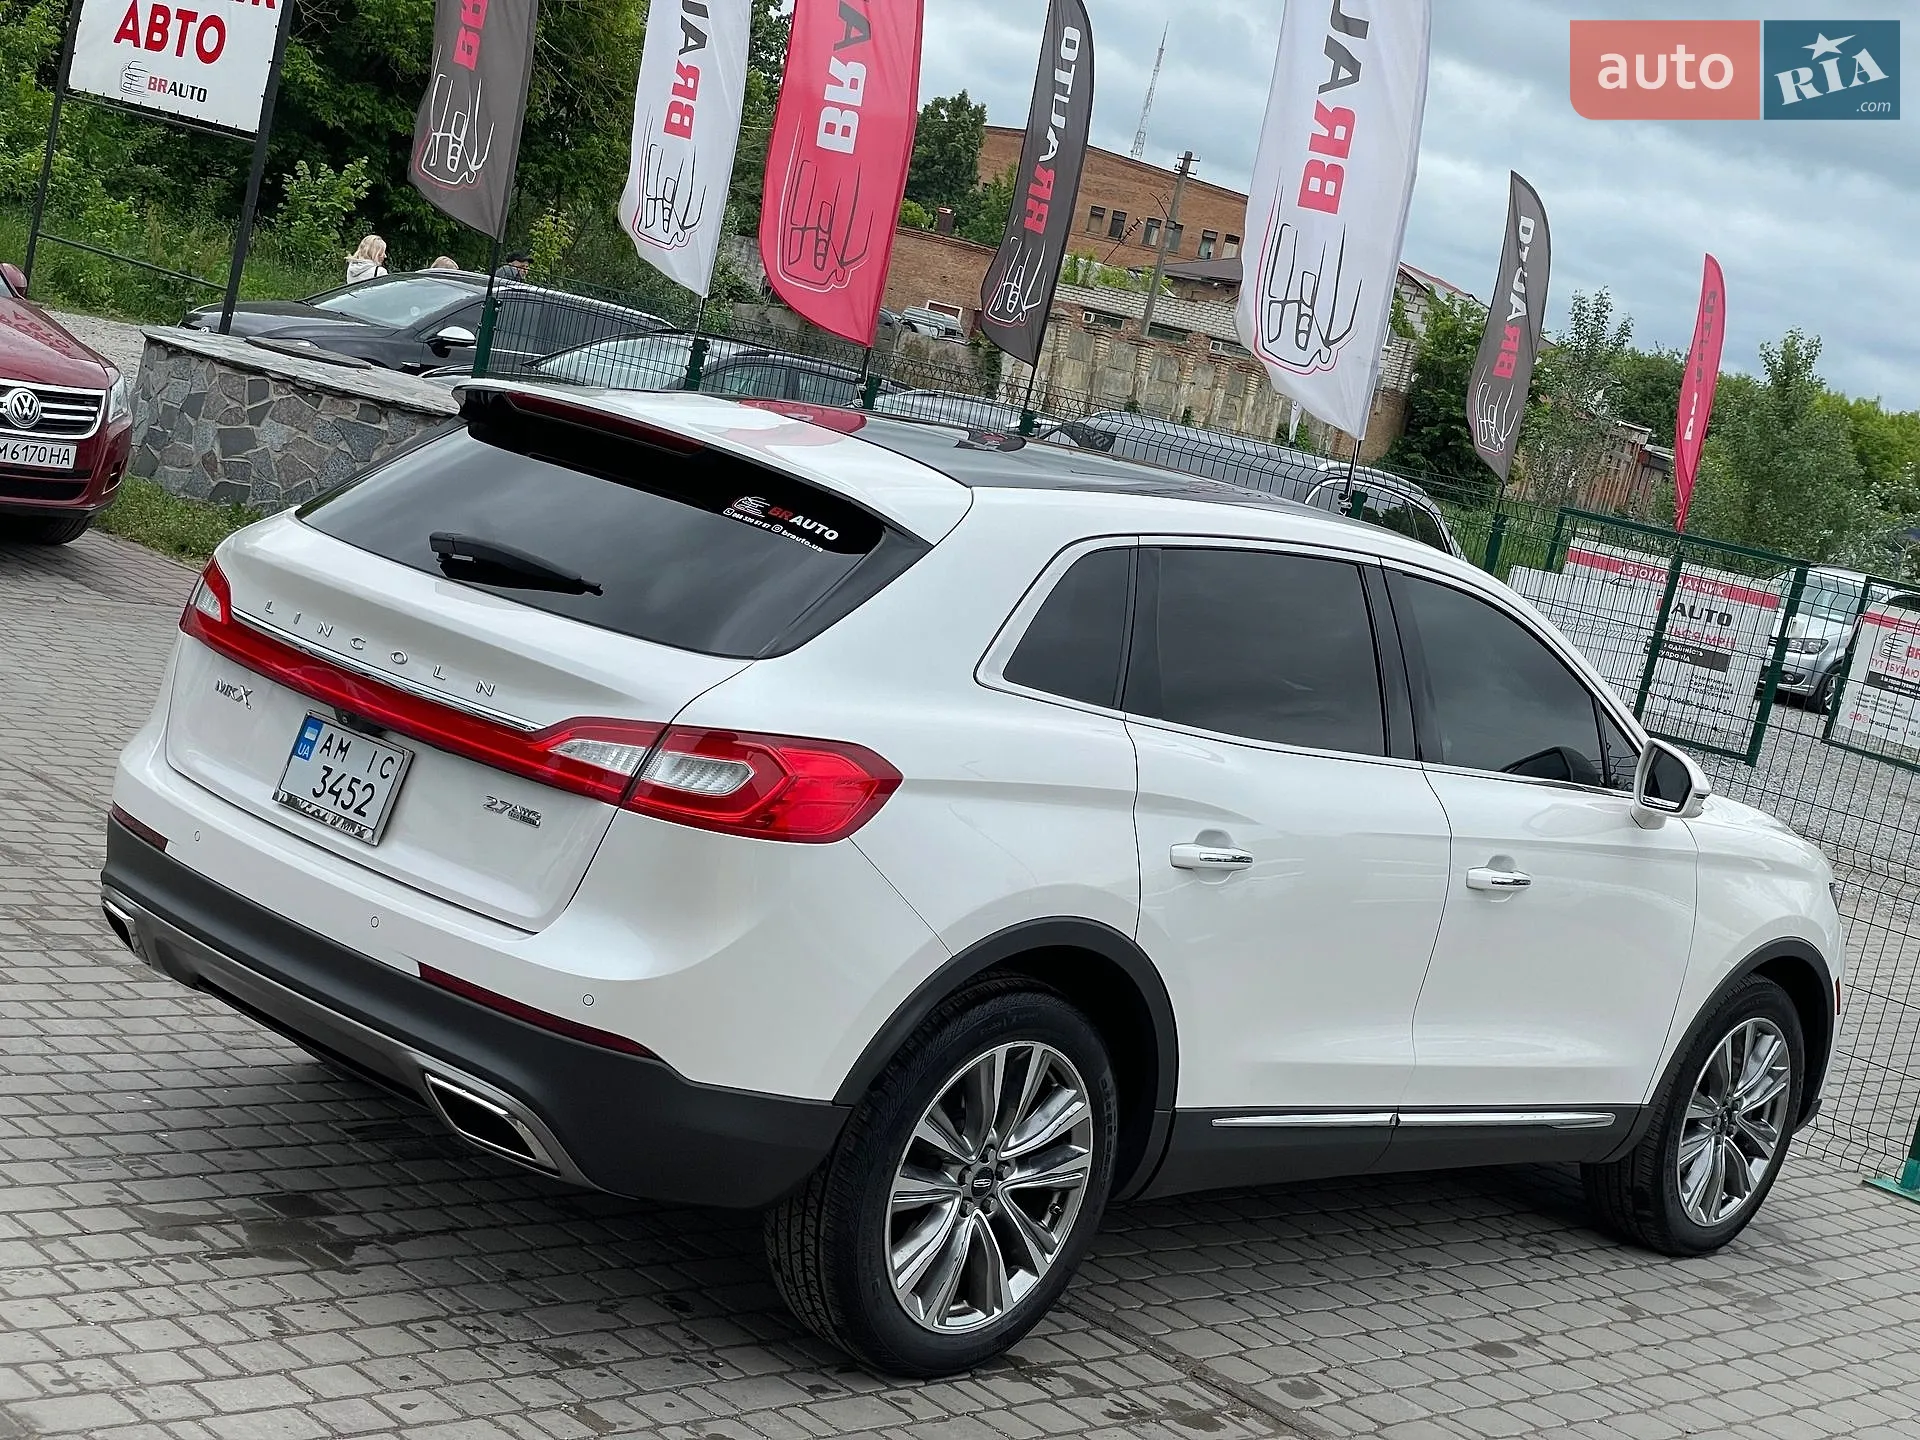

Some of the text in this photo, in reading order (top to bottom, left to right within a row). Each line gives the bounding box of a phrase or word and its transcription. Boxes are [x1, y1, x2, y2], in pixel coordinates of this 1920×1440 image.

[113, 0, 227, 65] АВТО
[147, 75, 208, 103] BRAUTO
[10, 444, 47, 463] 6170
[49, 447, 70, 466] HA
[768, 507, 839, 541] BRAUTO
[781, 530, 824, 553] brauto.ua
[264, 600, 496, 697] LINCOLN
[215, 679, 253, 710] MKX
[297, 742, 311, 758] UA
[319, 733, 395, 779] AM IC
[312, 765, 375, 818] 3452
